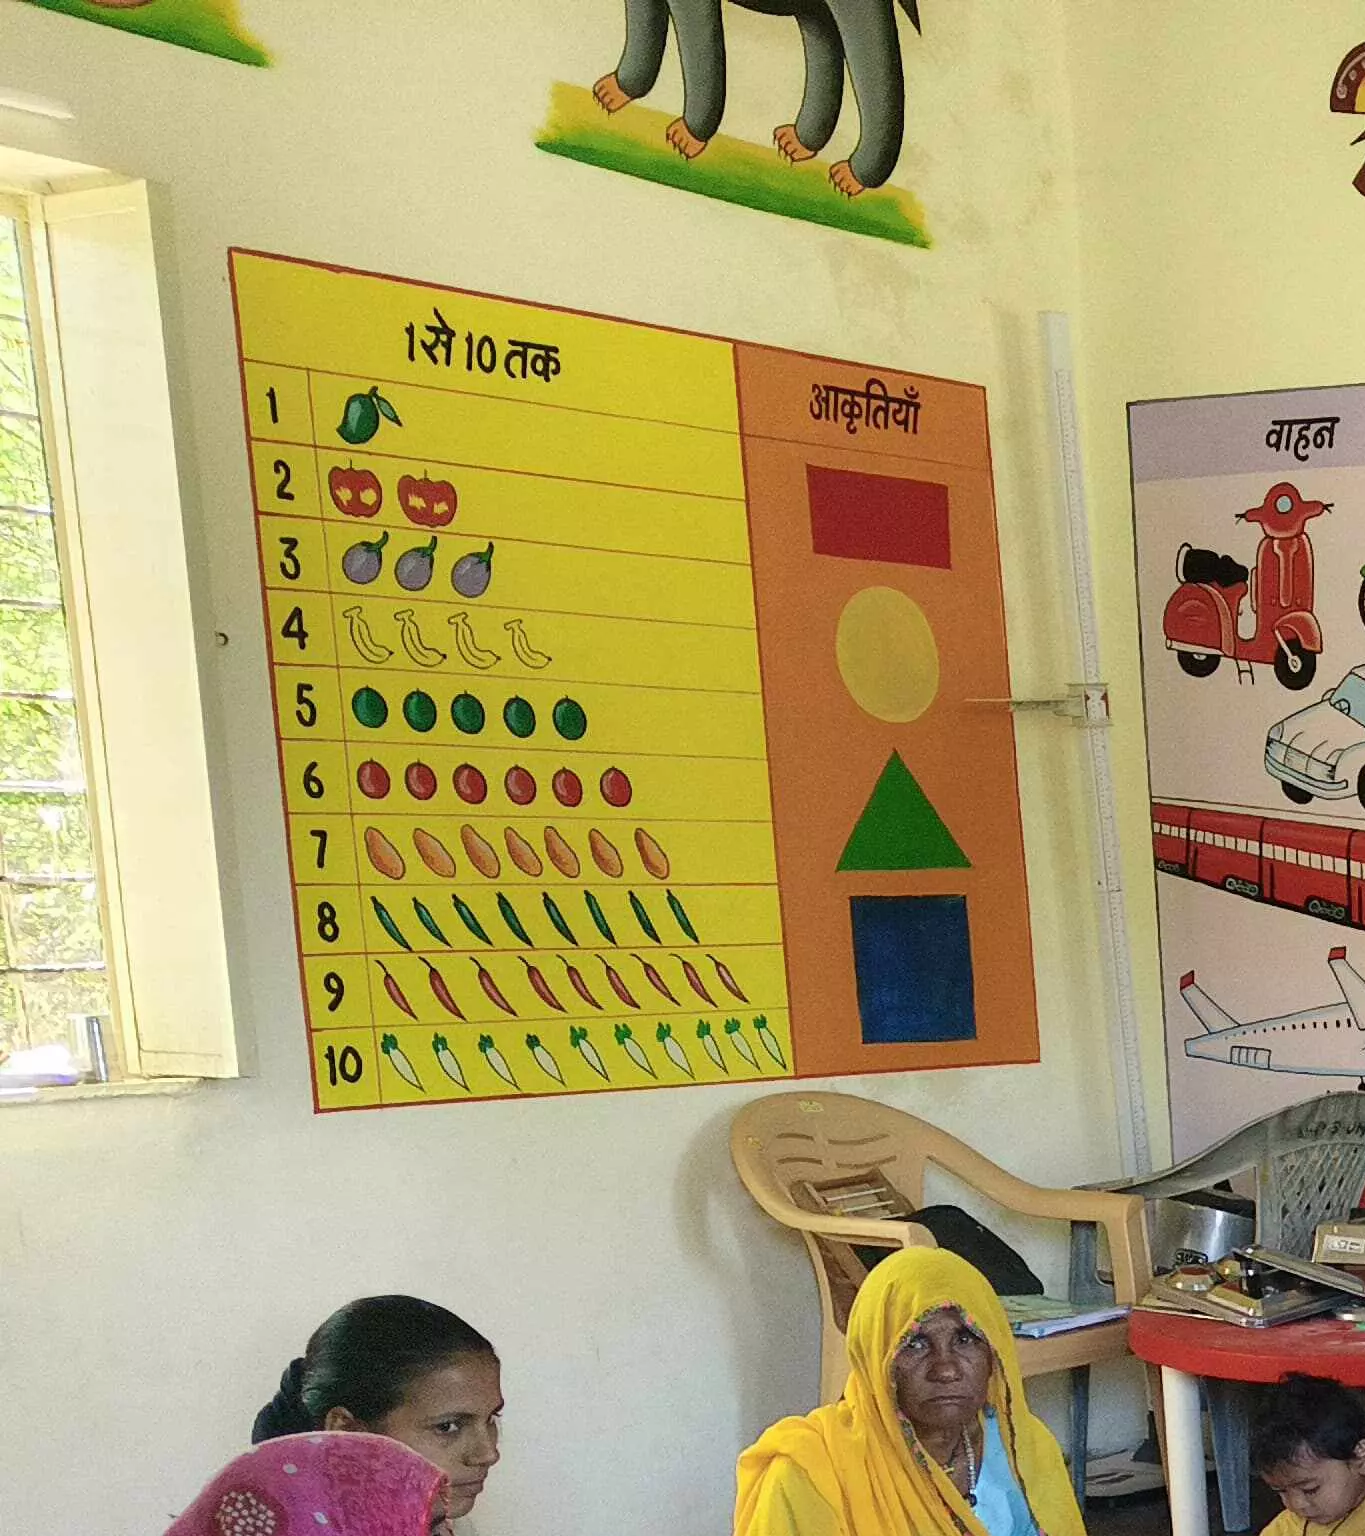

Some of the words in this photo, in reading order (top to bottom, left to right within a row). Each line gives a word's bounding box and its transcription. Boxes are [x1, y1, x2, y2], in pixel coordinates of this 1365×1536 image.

[464, 332, 496, 372] 10
[504, 340, 561, 383] तक
[267, 389, 277, 422] 1
[809, 383, 920, 434] आकृतियाँ
[1265, 416, 1340, 461] वाहन
[274, 463, 293, 499] 2
[279, 538, 302, 580] 3
[282, 611, 308, 649] 4
[295, 683, 317, 726] 5
[303, 760, 324, 799] 6
[311, 830, 328, 870] 7
[317, 902, 339, 942] 8
[324, 970, 345, 1012] 9
[324, 1044, 362, 1084] 10
